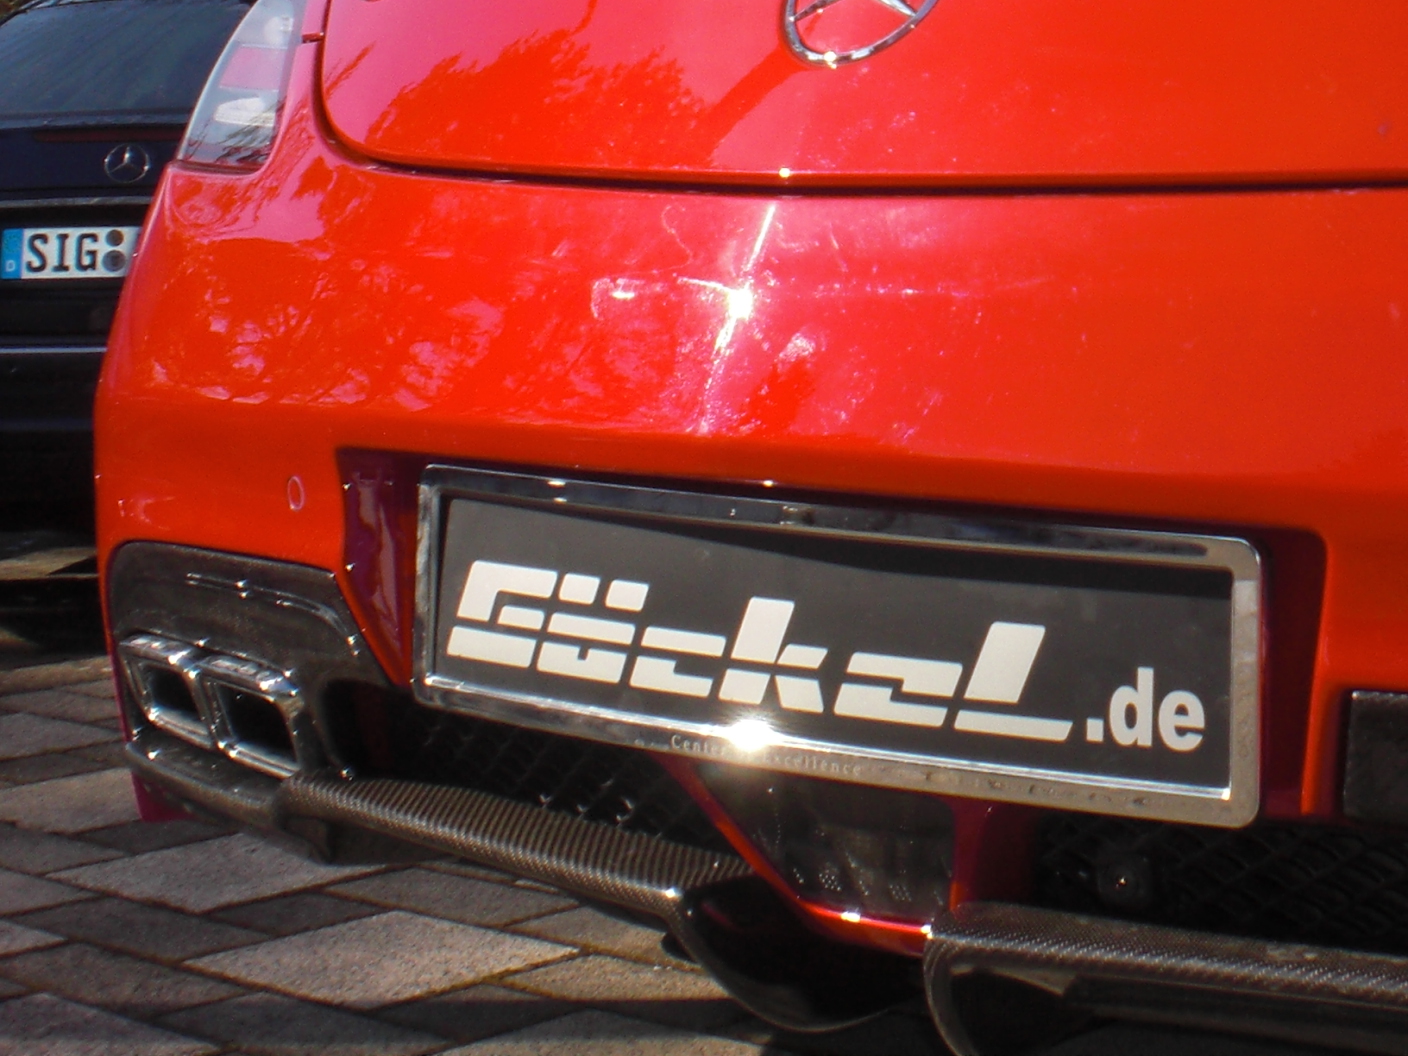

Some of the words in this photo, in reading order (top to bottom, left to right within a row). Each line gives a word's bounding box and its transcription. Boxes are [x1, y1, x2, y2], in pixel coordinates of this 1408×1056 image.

[26, 232, 98, 273] SIG
[670, 734, 726, 756] Center
[762, 752, 862, 776] Excellence
